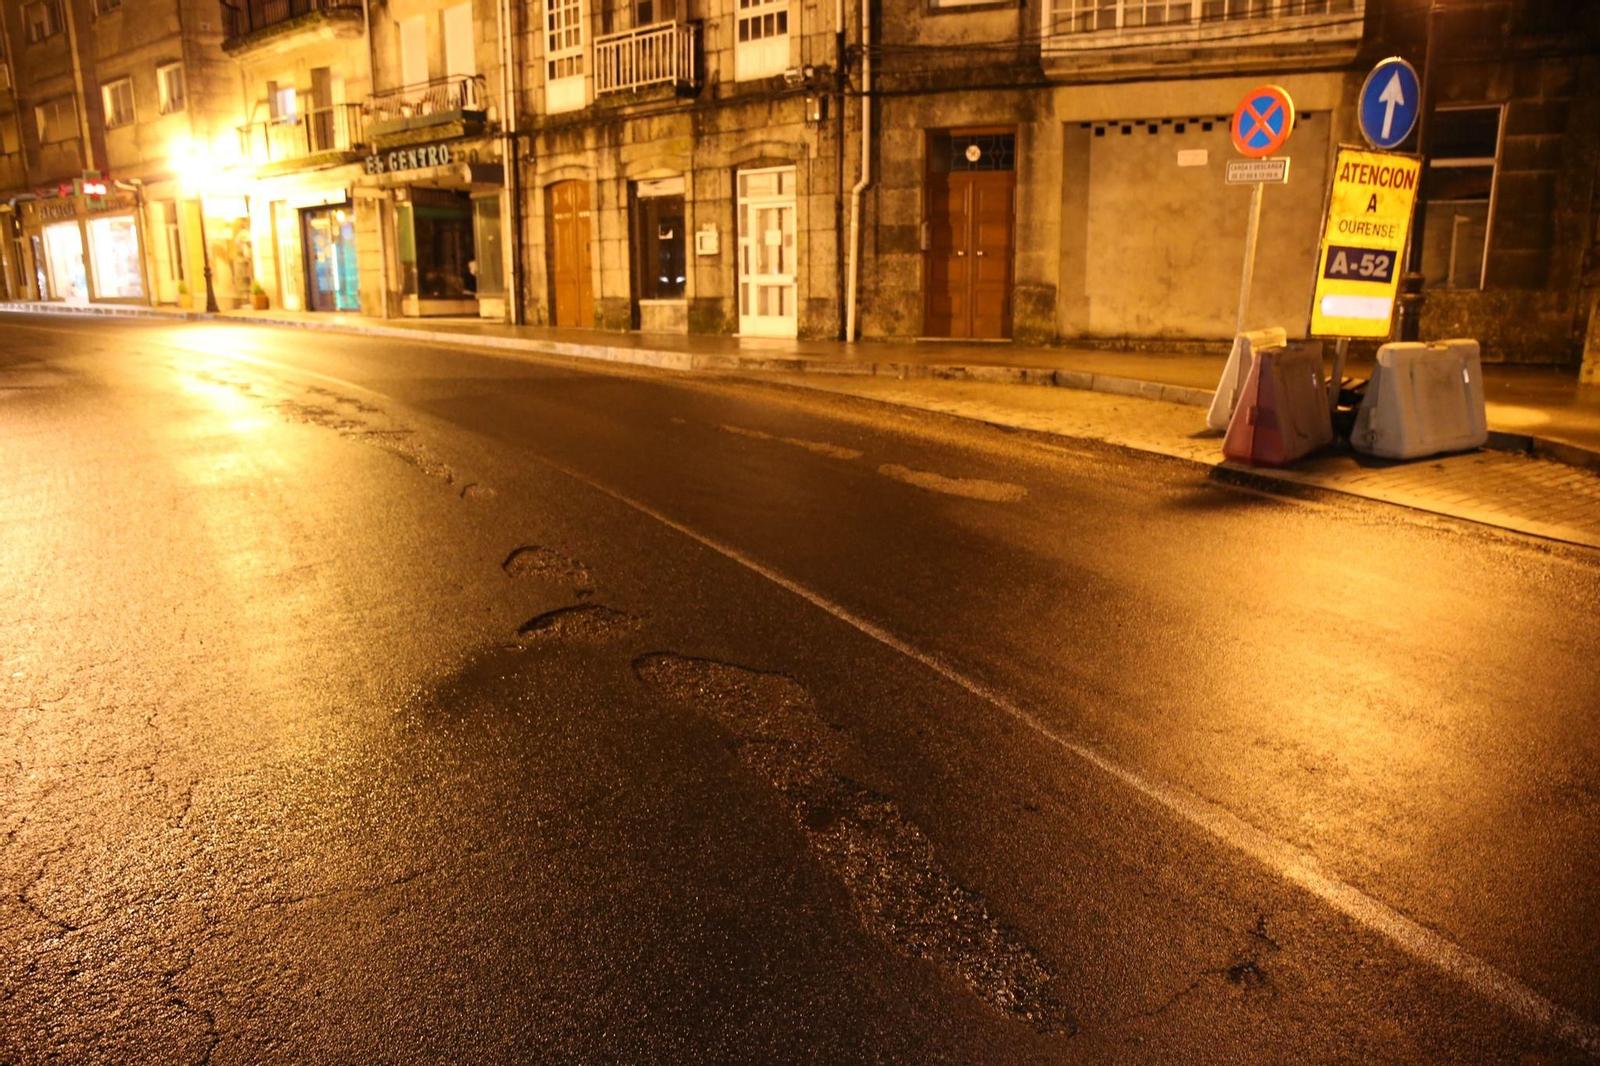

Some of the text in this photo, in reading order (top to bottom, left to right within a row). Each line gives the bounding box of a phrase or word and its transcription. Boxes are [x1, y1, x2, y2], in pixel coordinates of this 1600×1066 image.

[389, 143, 449, 172] CENTRO
[1339, 161, 1416, 190] ATENCION
[1366, 193, 1377, 213] A
[1338, 220, 1396, 238] OURENSE
[1329, 250, 1390, 278] A-52
